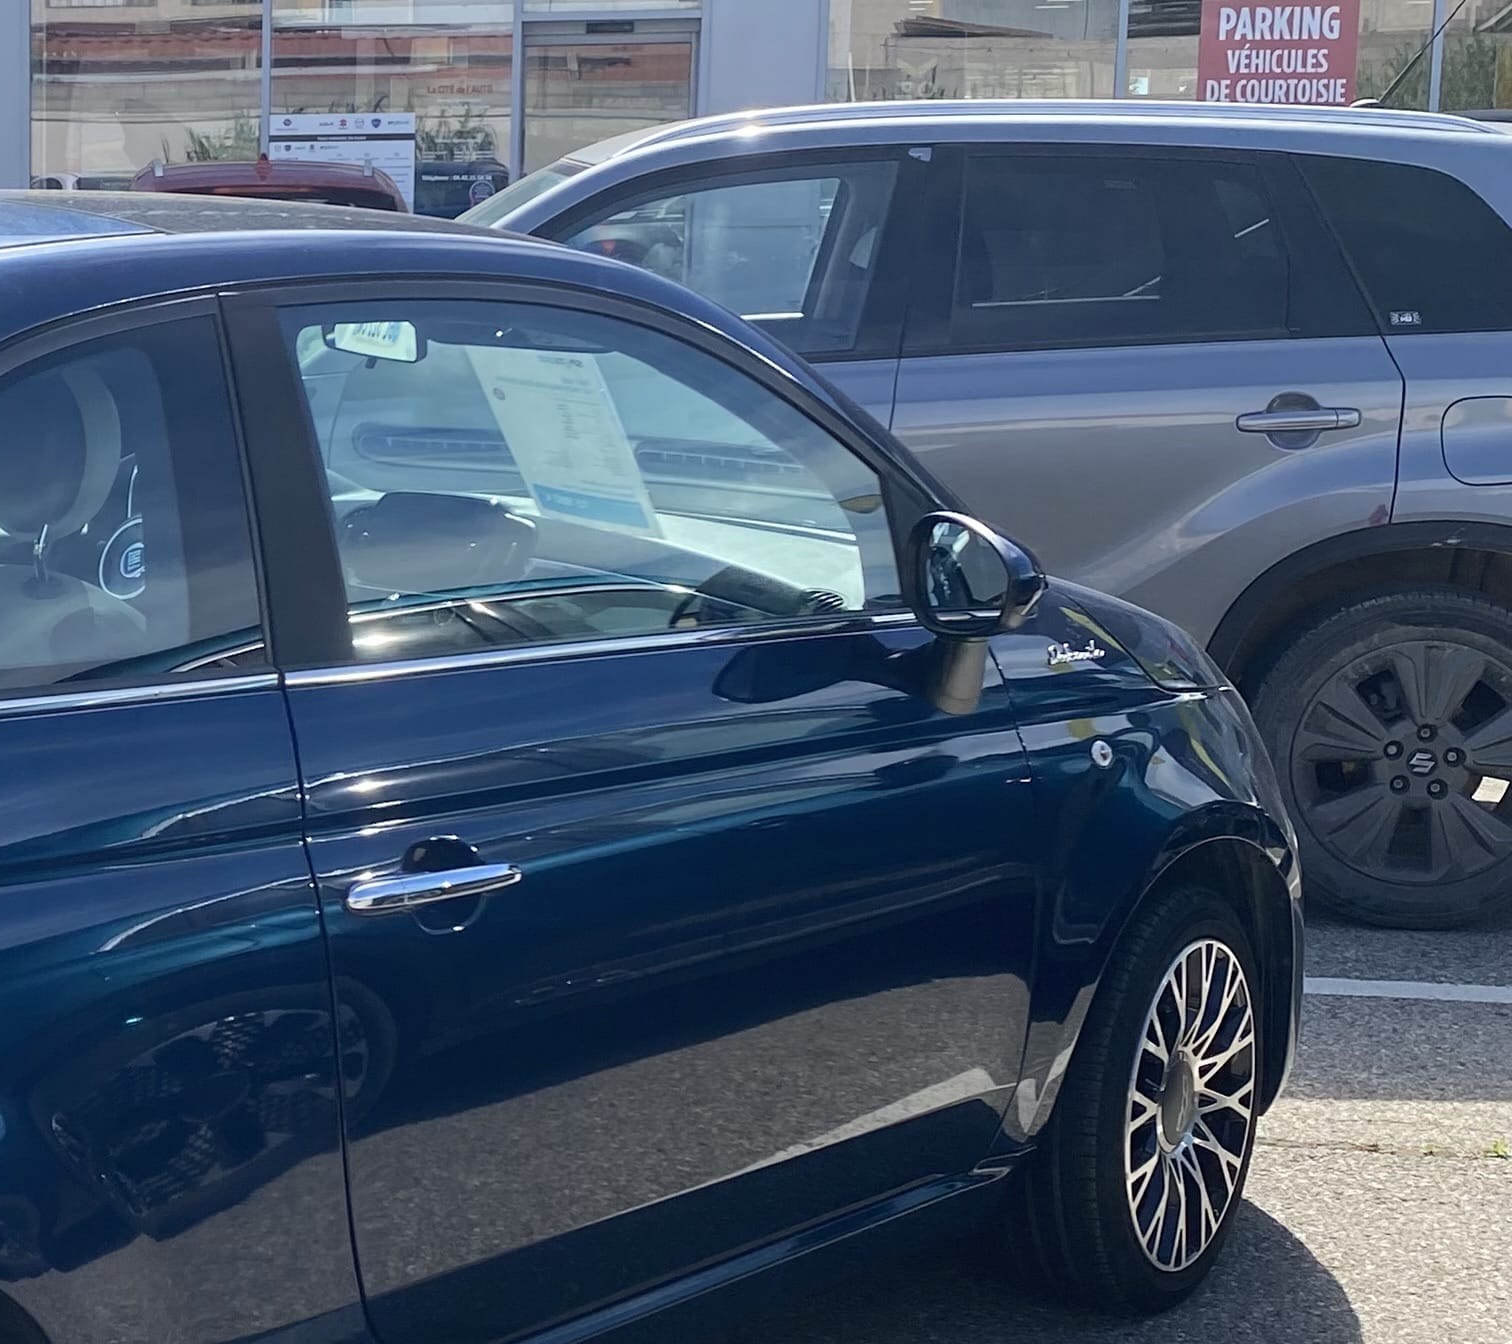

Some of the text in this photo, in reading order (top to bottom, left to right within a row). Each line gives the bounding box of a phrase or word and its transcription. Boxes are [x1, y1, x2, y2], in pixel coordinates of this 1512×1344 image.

[1218, 5, 1341, 41] PARKING
[1227, 43, 1329, 73] VÉHICULES
[1205, 78, 1347, 104] DE COURTOISIE
